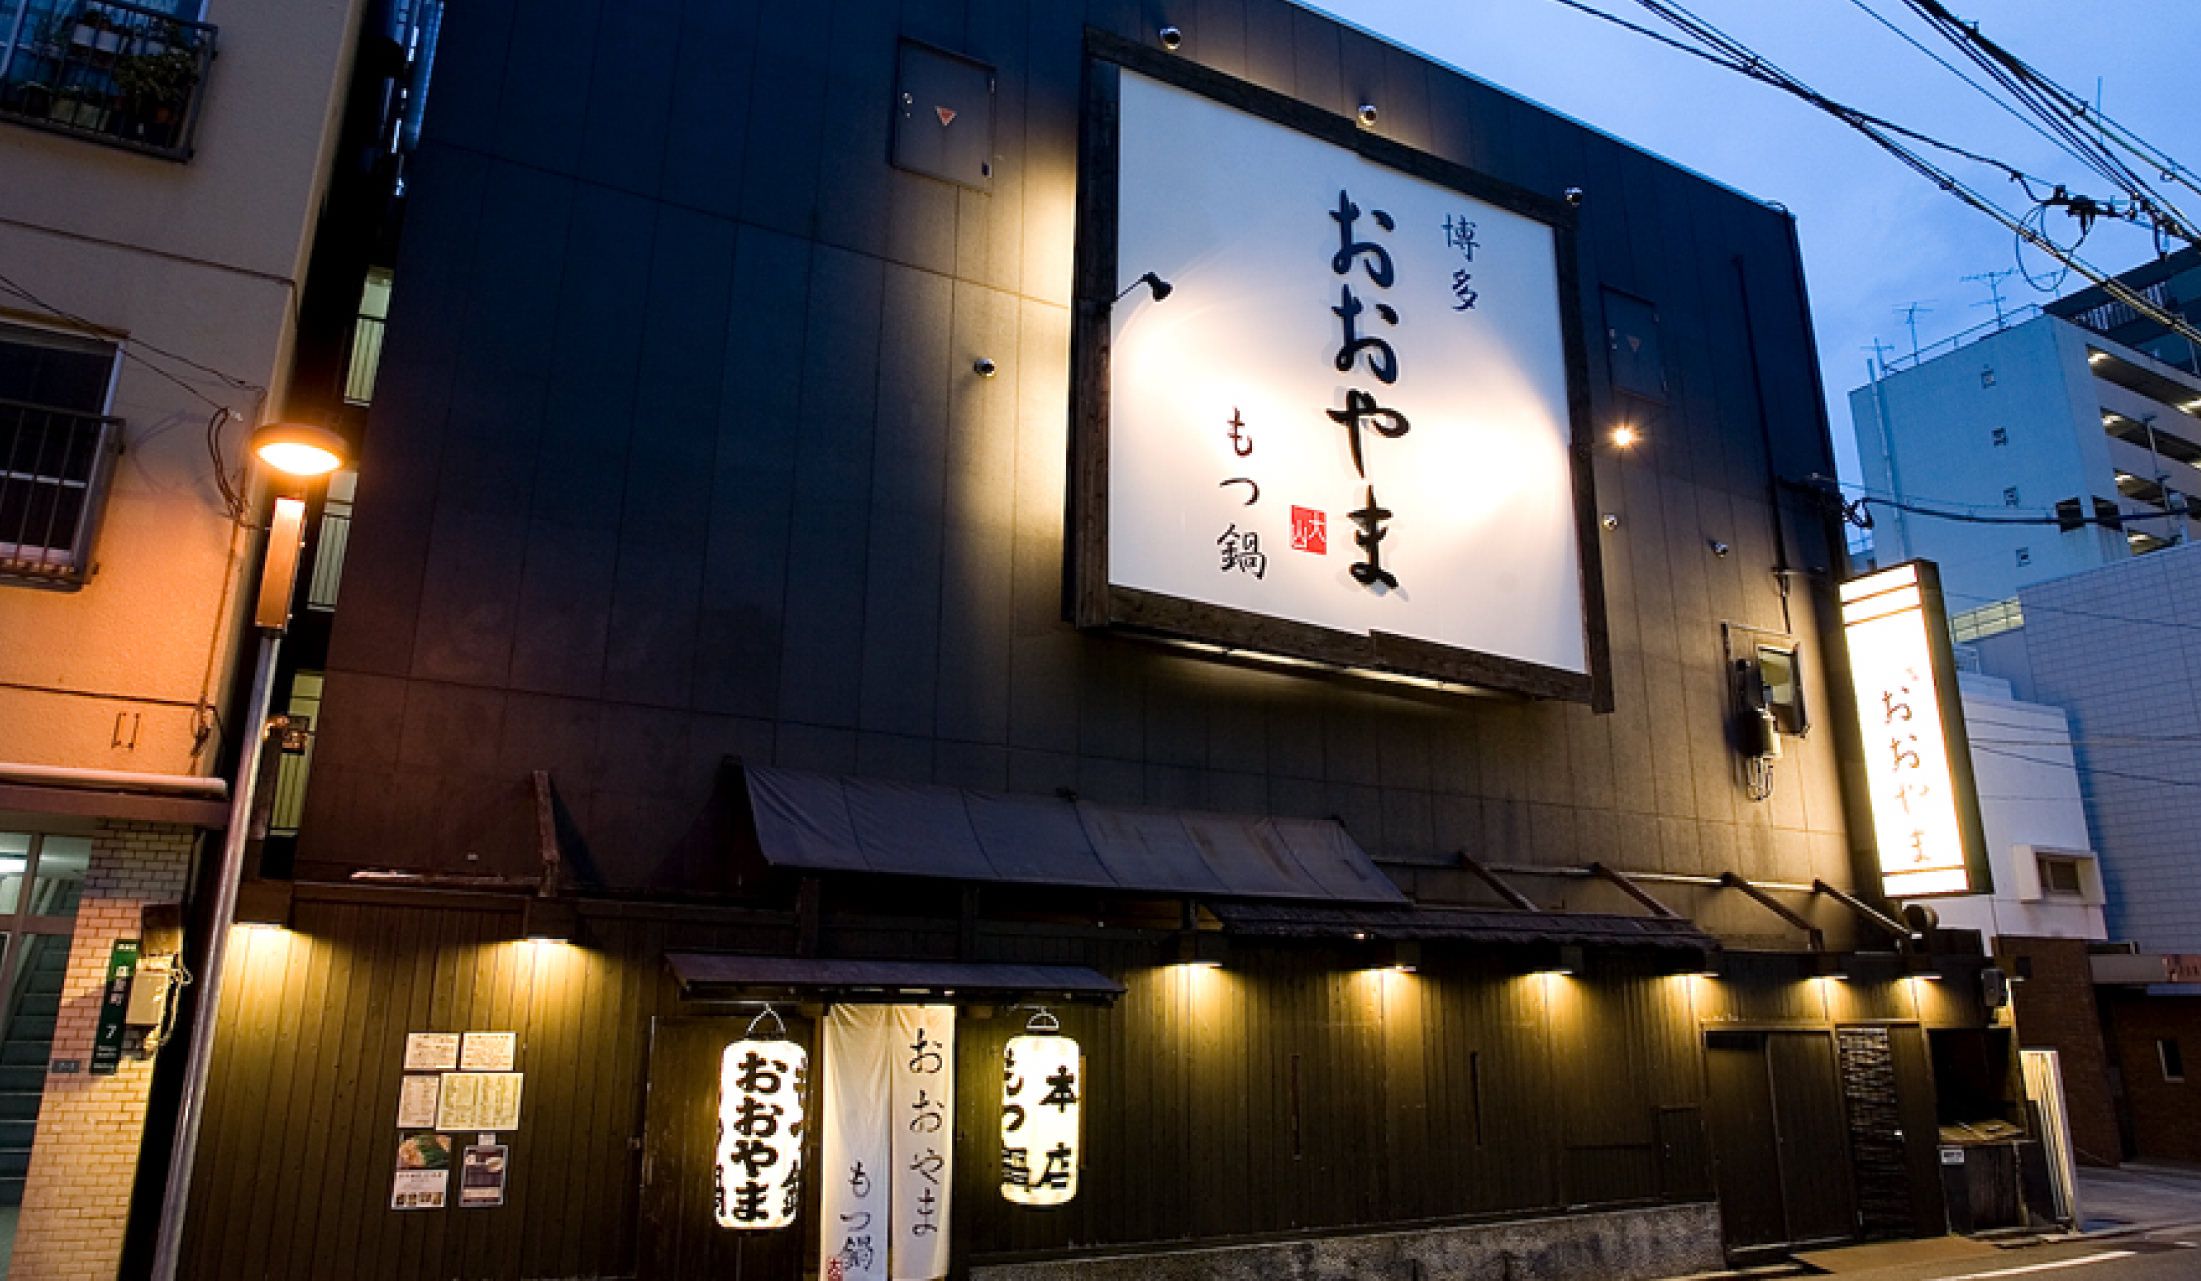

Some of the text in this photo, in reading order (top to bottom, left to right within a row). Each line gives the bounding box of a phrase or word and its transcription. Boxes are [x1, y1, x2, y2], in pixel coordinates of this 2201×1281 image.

[1441, 212, 1482, 312] 博多
[1326, 189, 1410, 591] おおやま
[1217, 407, 1266, 581] もつ鍋
[1880, 685, 1932, 864] おおやま
[730, 1051, 789, 1223] おおやま
[909, 1028, 945, 1238] おおやま
[1037, 1064, 1077, 1190] 本店
